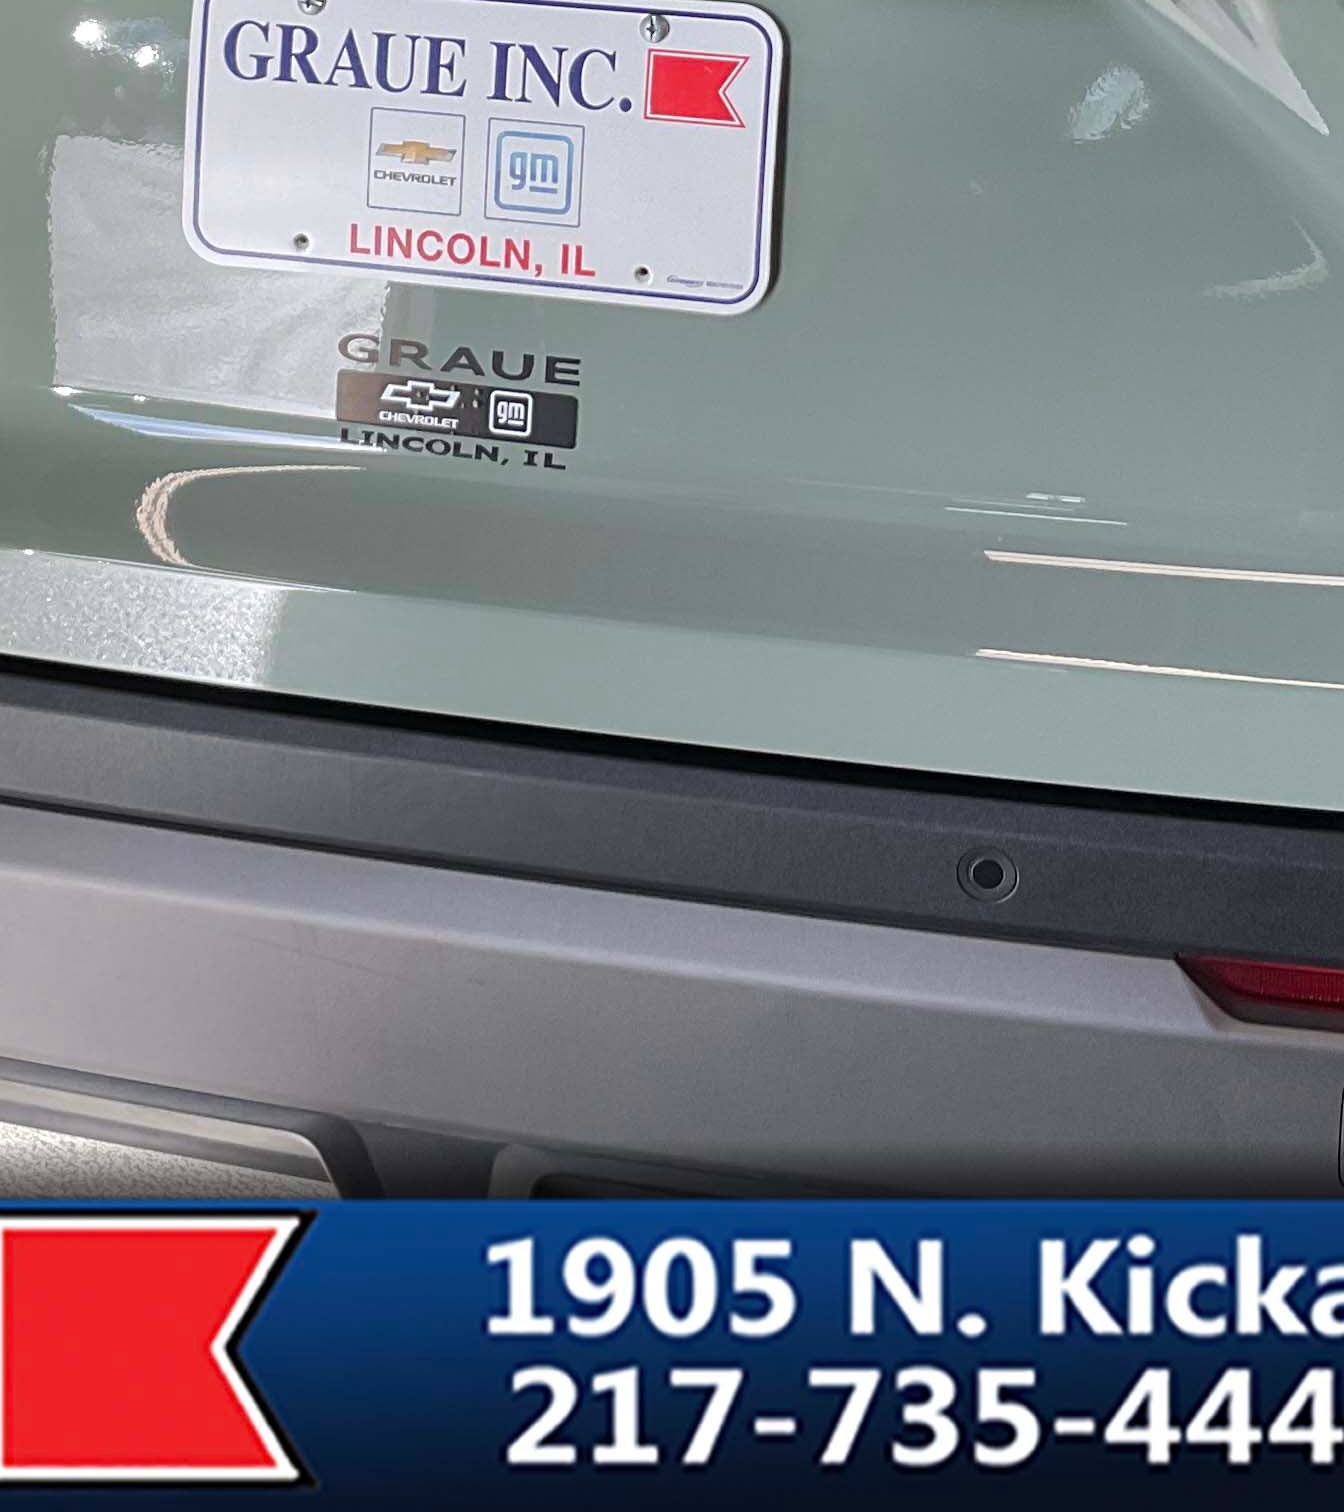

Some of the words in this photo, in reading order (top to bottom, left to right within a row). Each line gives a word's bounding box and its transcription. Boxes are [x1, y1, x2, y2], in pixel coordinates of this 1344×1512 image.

[223, 19, 469, 97] GRAUE
[486, 41, 633, 114] INC.
[373, 168, 457, 188] CHEVROLET
[509, 152, 559, 195] gm
[349, 222, 543, 277] LINCOLN,
[560, 244, 596, 278] IL
[337, 332, 581, 387] GRAUE
[378, 409, 459, 430] CHEVROLET
[497, 399, 526, 426] gm
[339, 427, 510, 467] LINCOLN,
[523, 449, 567, 470] IL
